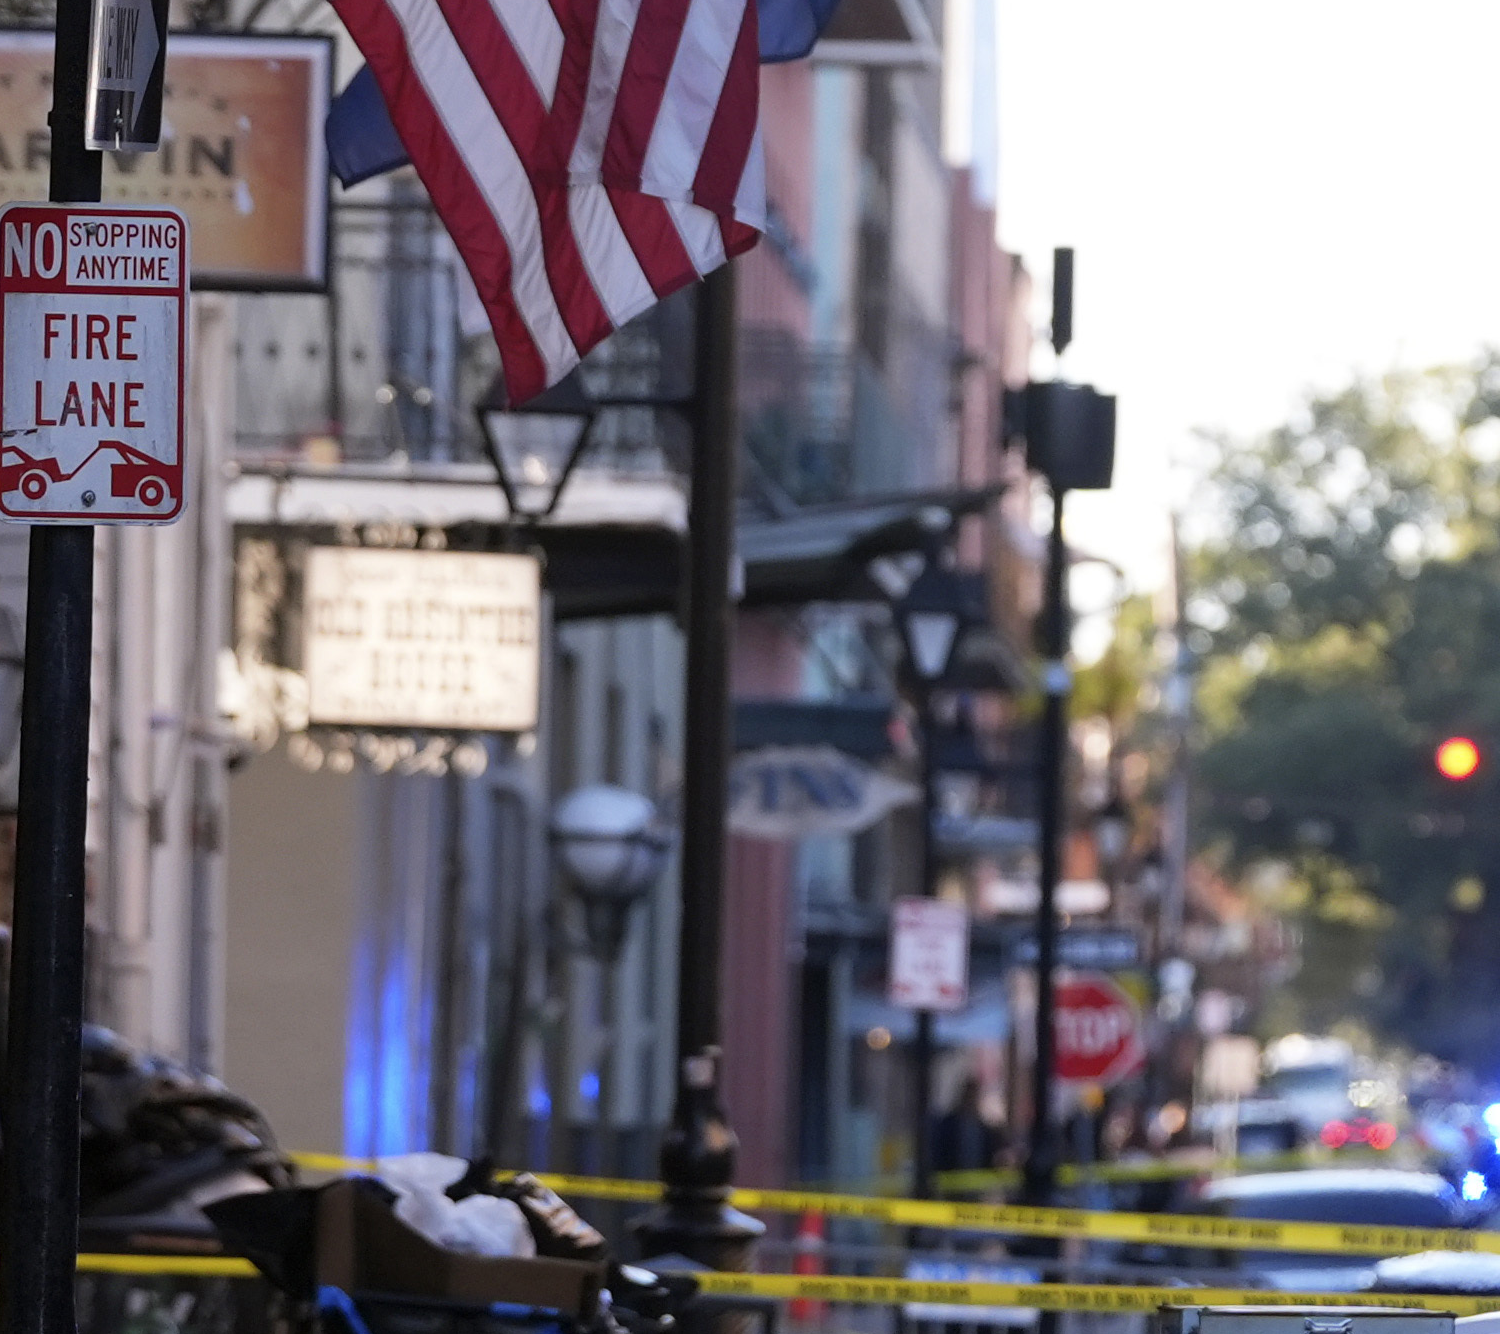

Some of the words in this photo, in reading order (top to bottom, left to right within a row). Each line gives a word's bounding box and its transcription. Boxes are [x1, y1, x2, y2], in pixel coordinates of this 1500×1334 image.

[3, 221, 63, 280] NO
[69, 222, 178, 250] STOPPING
[75, 255, 170, 282] ANYTIME
[43, 313, 139, 361] FIRE
[34, 380, 146, 429] LANE
